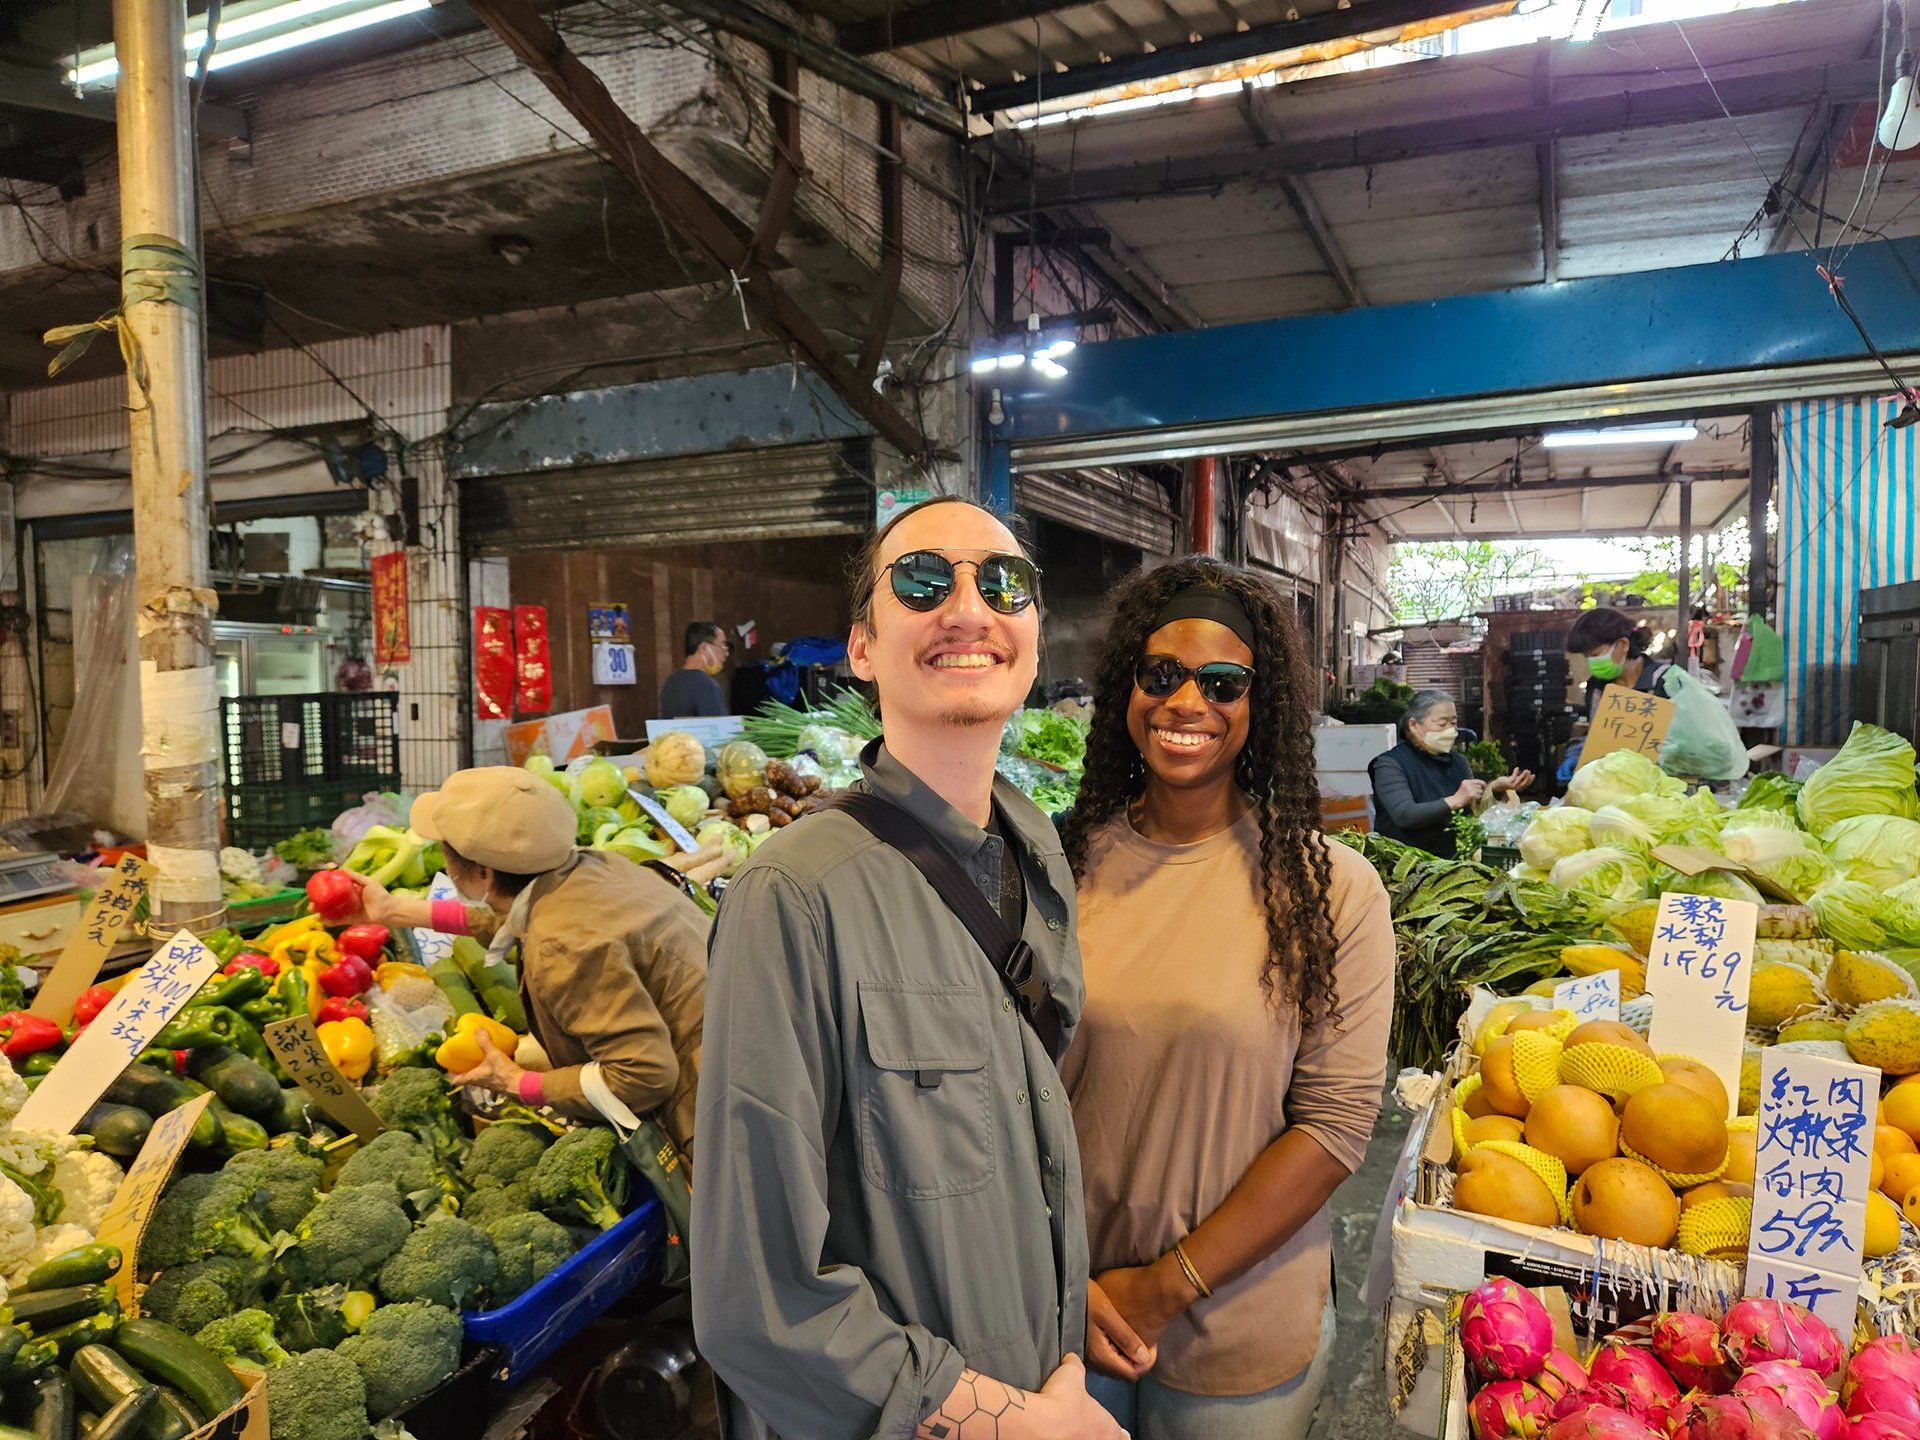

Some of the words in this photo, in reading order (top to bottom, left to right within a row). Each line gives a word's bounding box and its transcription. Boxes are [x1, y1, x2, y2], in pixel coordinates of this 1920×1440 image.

[608, 648, 627, 673] 30
[1608, 693, 1658, 717] 大白菜
